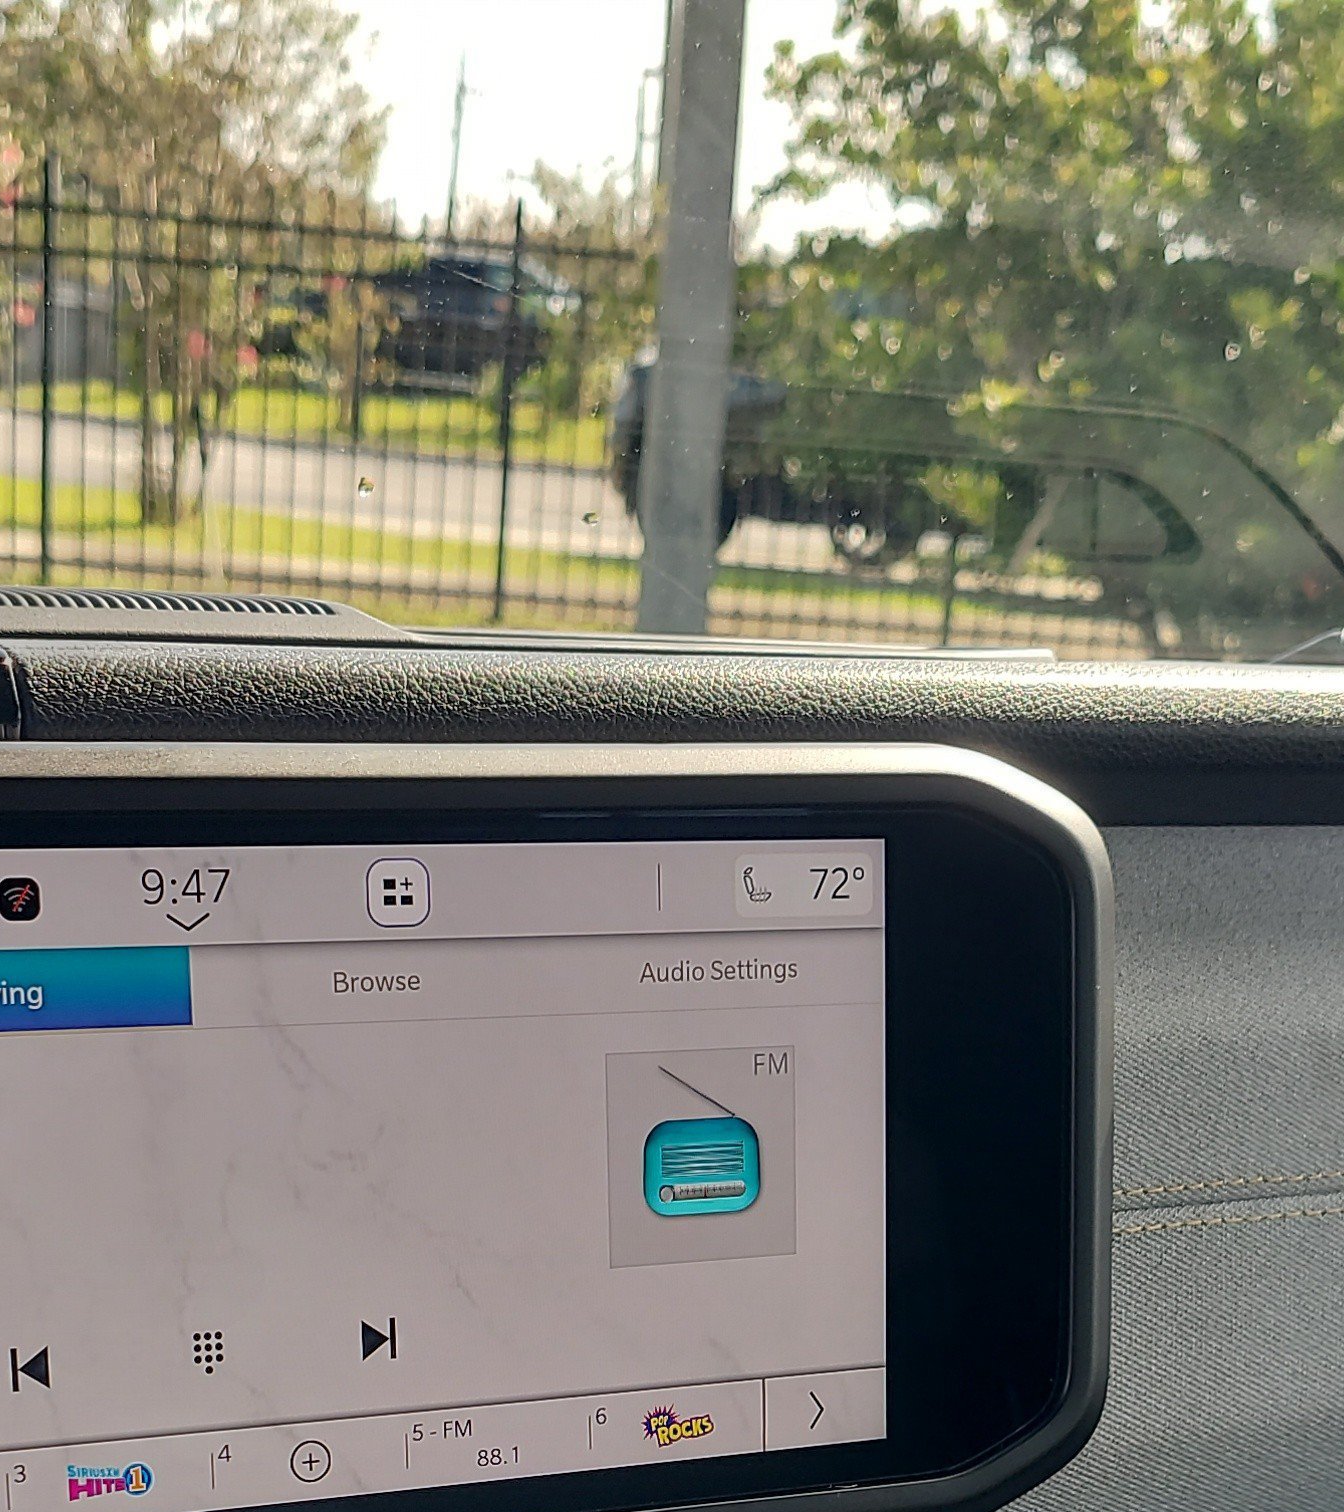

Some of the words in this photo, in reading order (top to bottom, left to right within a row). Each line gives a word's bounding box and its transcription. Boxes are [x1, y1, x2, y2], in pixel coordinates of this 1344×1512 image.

[140, 867, 232, 906] 9:47
[808, 865, 866, 902] 72°
[332, 970, 422, 994] Browse
[639, 960, 706, 985] Audio
[710, 957, 799, 984] Settings
[753, 1051, 790, 1076] FM
[595, 1407, 608, 1426] 6
[411, 1422, 426, 1442] 5
[441, 1419, 474, 1441] FM
[657, 1415, 714, 1446] ROCKS
[217, 1443, 233, 1464] 4
[476, 1445, 522, 1469] 88.1
[12, 1463, 28, 1484] 3
[67, 1477, 126, 1502] HITS
